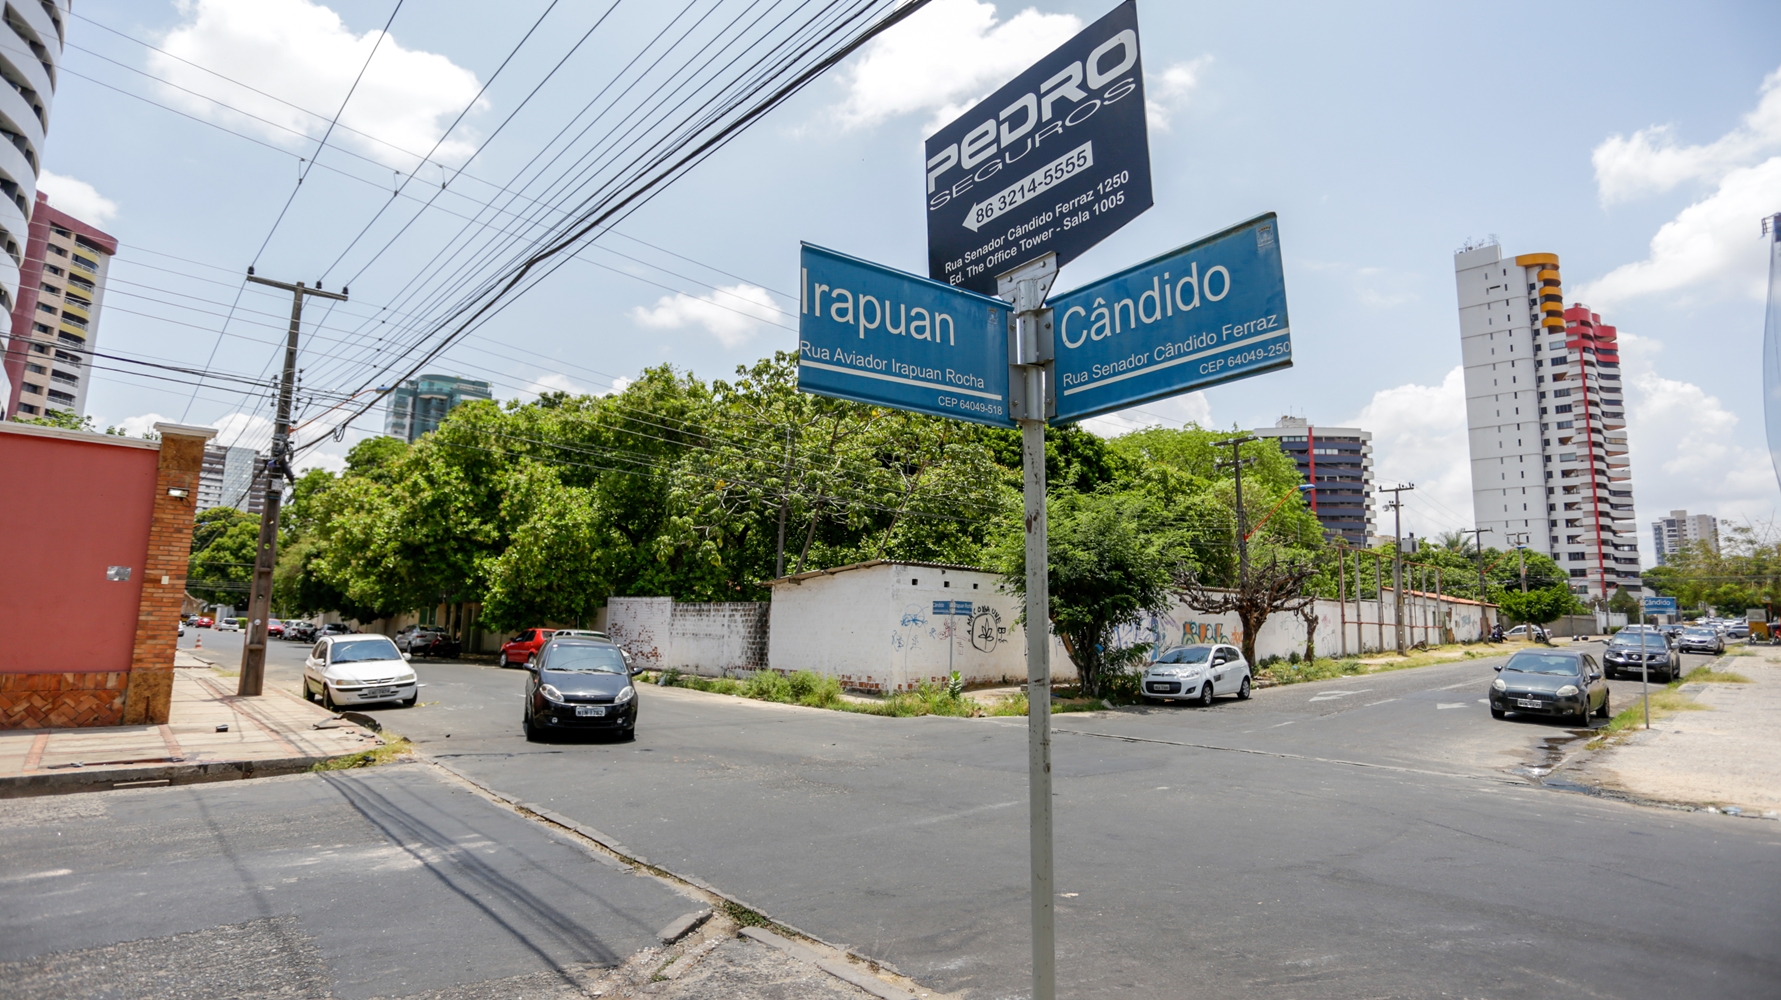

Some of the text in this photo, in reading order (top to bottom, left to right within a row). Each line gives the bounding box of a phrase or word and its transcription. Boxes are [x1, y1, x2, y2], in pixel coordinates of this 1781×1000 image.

[929, 77, 1136, 211] SEGUROS
[945, 170, 1129, 274] Rua Senador Cândido Ferraz 1250
[975, 149, 1088, 224] 86 3214-5555
[949, 272, 965, 287] Ed.
[966, 263, 984, 278] The
[986, 245, 1017, 269] Office
[1018, 227, 1054, 252] Tower
[1063, 209, 1090, 231] Sala
[1092, 190, 1125, 217] 1005
[802, 267, 955, 346] Irapuan
[1061, 261, 1231, 350] Cândido
[800, 340, 984, 389] Rua Aviador Irapuan Rocha
[1063, 313, 1278, 388] Rua Senador Cândido Ferraz
[1200, 341, 1291, 376] CEP 64049-250
[937, 395, 1003, 416] CEP 64049-518
